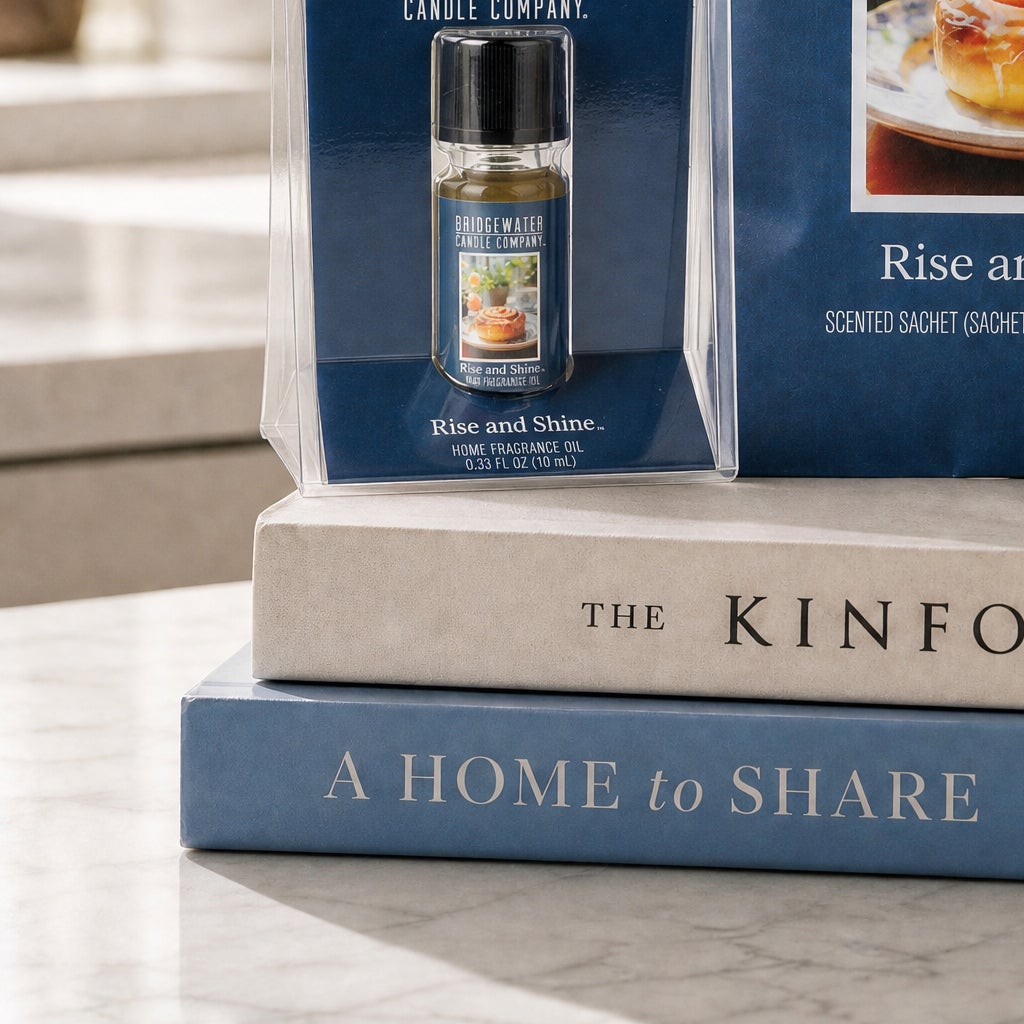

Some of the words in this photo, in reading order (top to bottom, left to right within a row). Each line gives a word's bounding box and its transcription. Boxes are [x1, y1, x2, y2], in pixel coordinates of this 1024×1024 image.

[455, 215, 543, 233] BRIDGEWATER
[455, 235, 491, 249] CANDLE
[881, 243, 973, 281] Rise
[825, 310, 894, 334] SCENTED
[899, 310, 958, 335] SACHET
[460, 363, 483, 374] Rise
[485, 364, 506, 375] and
[510, 363, 540, 375] Shine
[430, 418, 480, 436] Rise
[486, 415, 528, 434] and
[532, 414, 595, 433] Shine
[452, 443, 487, 457] HOME
[490, 441, 560, 456] FRAGRANCE
[564, 440, 584, 453] OIL
[465, 457, 492, 470] 0.33
[496, 457, 509, 470] FL
[513, 456, 529, 469] OZ
[532, 456, 550, 470] (10
[554, 455, 577, 469] mL)
[582, 602, 666, 631] THE
[323, 750, 370, 800] A
[400, 753, 620, 810] HOME
[649, 770, 703, 813] to
[731, 765, 979, 823] SHARE
